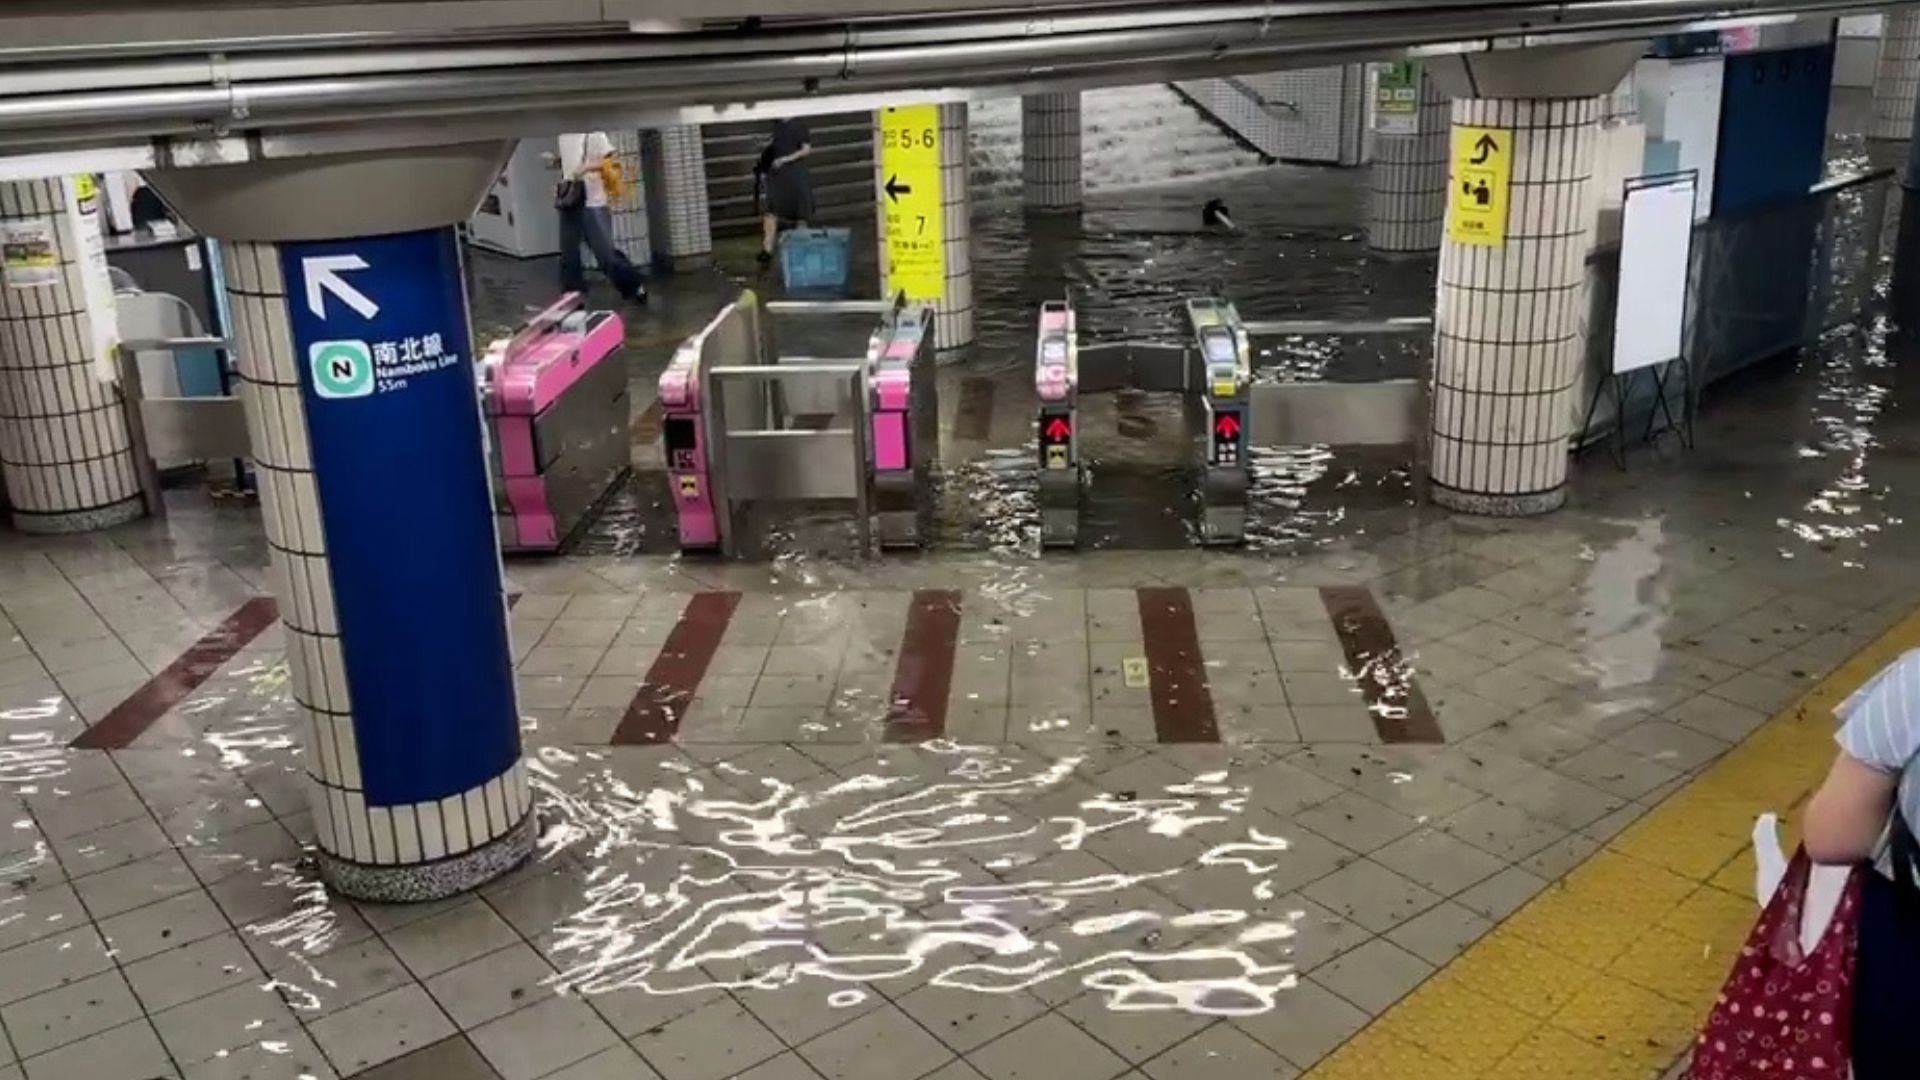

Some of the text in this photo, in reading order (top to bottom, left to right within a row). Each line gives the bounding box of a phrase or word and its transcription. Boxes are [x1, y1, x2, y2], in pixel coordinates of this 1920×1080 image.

[916, 215, 925, 235] 7
[372, 332, 444, 365] 南北線
[332, 360, 352, 378] N
[376, 359, 437, 379] Namboku
[377, 379, 408, 393] 55m
